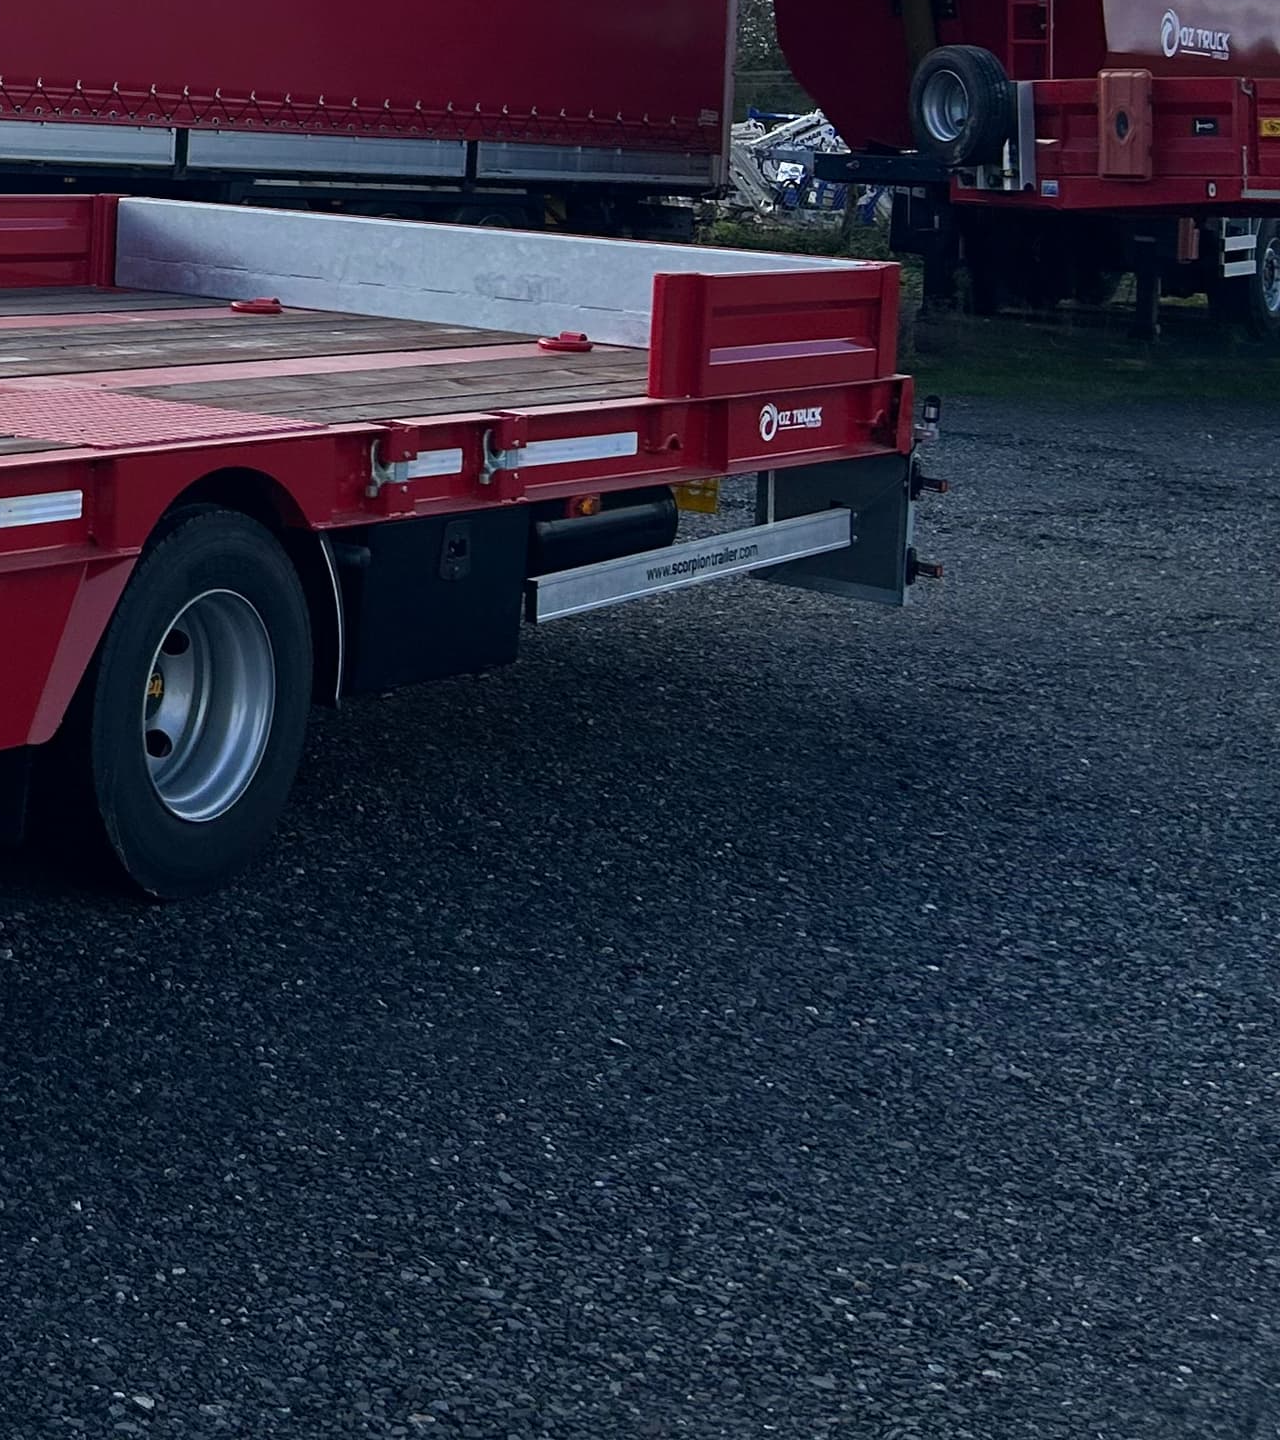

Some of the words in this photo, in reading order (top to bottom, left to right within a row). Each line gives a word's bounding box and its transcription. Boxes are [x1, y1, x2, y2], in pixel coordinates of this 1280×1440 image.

[1196, 28, 1231, 52] TRUCK
[792, 407, 823, 424] TRUCK
[646, 544, 758, 580] www.scorpiontrailer.com
